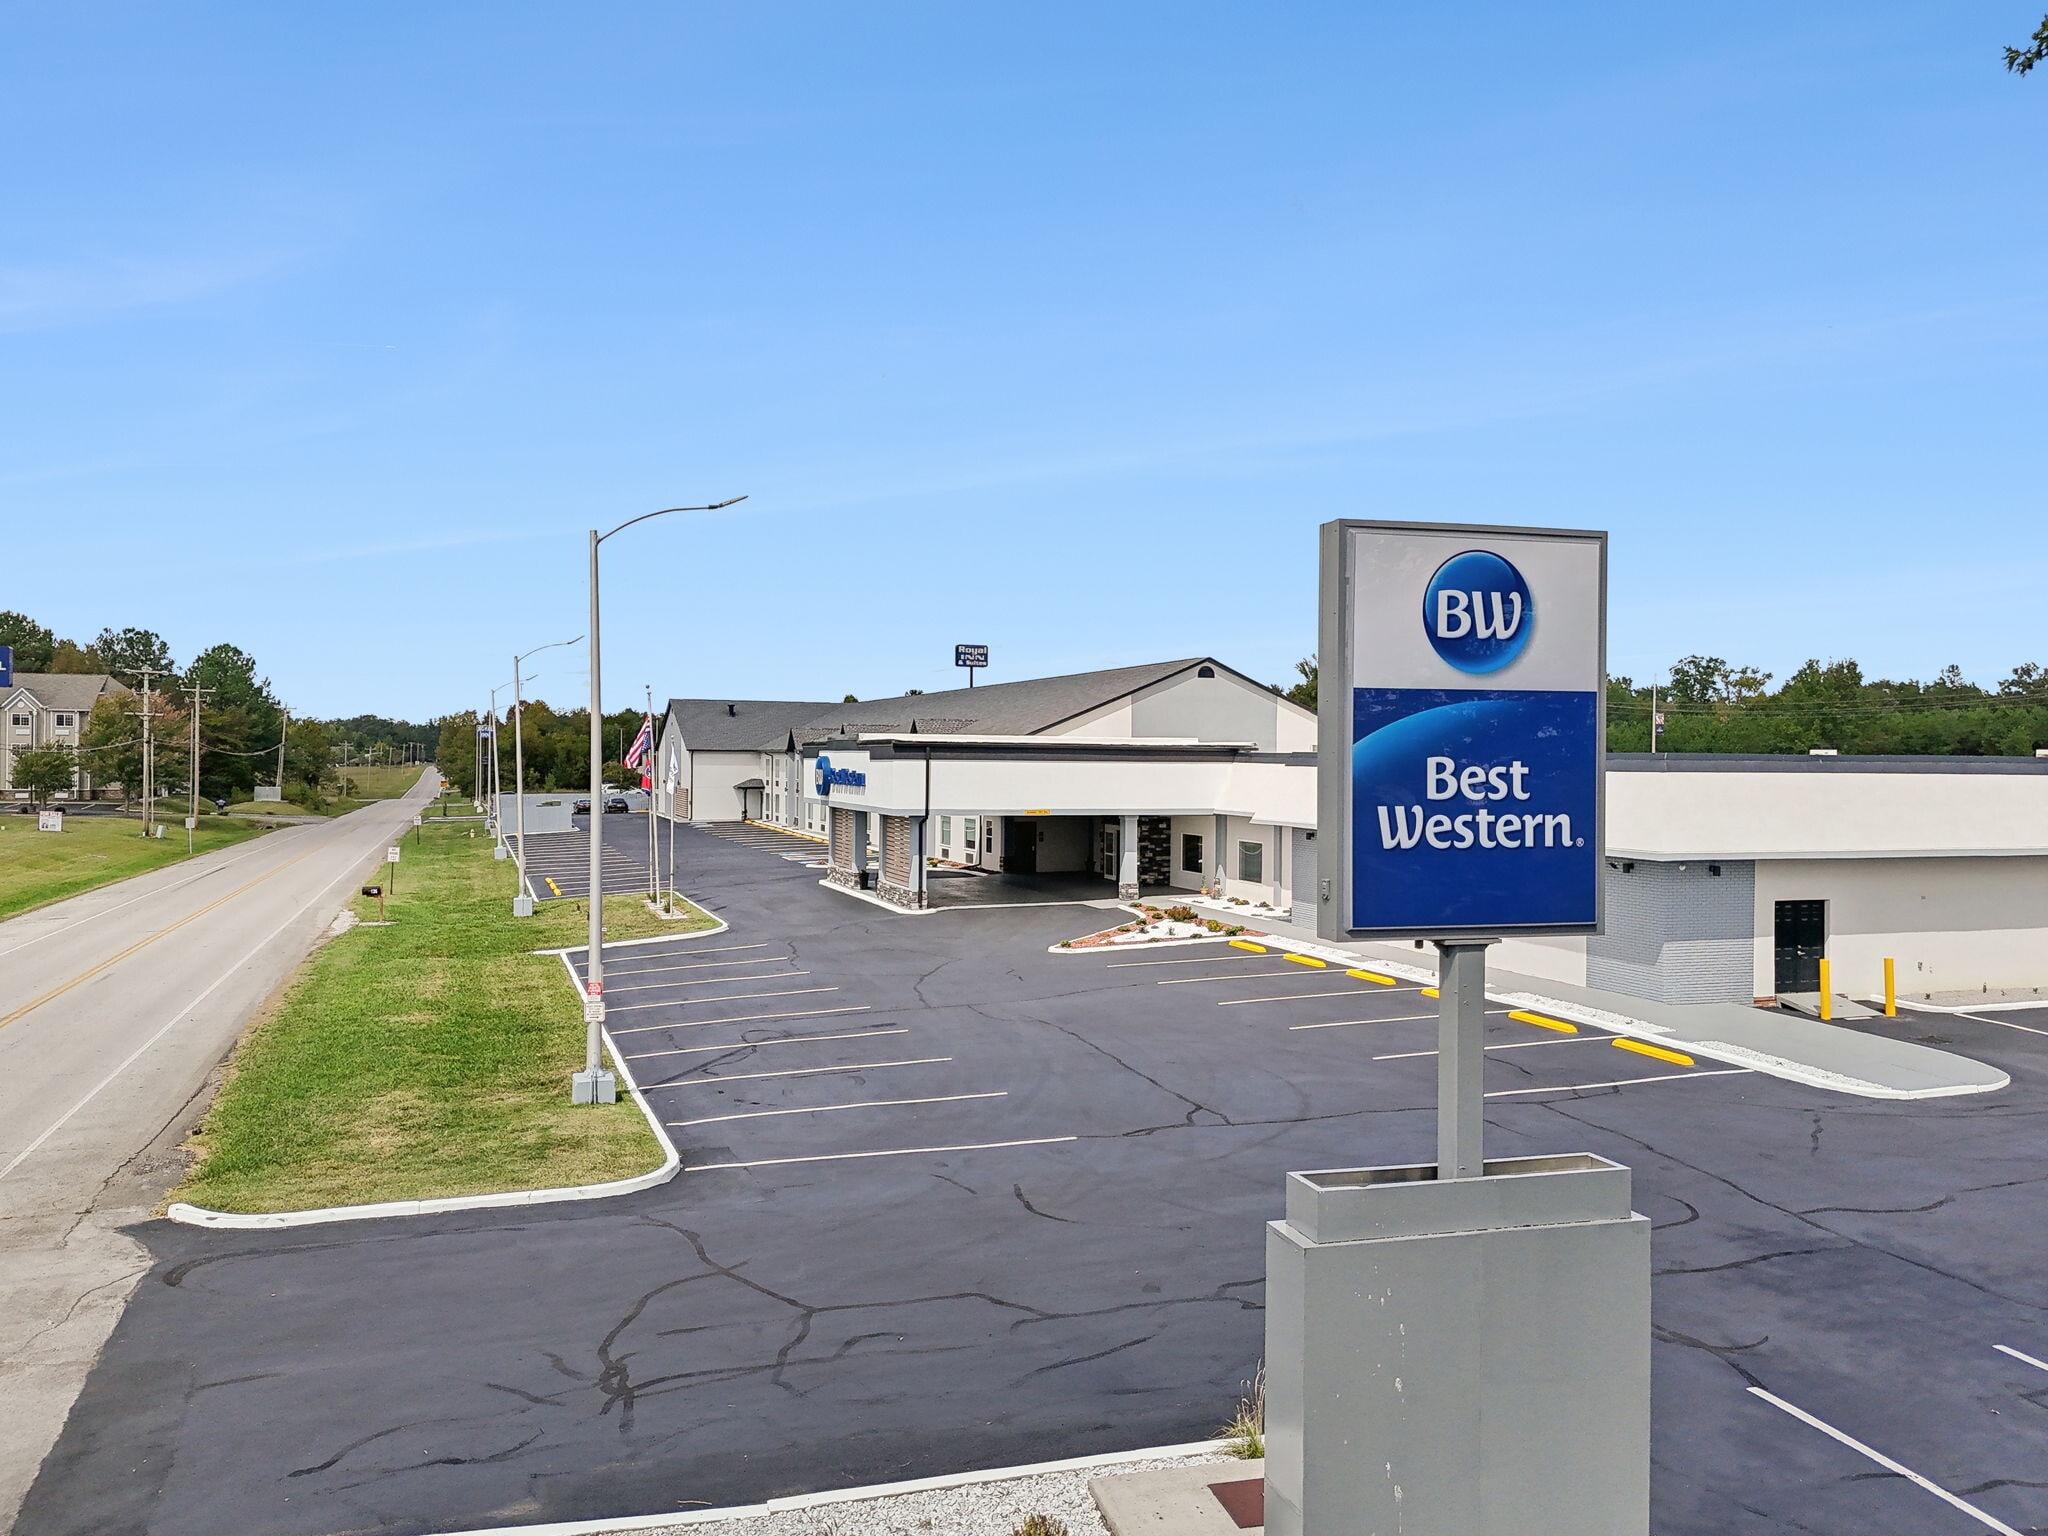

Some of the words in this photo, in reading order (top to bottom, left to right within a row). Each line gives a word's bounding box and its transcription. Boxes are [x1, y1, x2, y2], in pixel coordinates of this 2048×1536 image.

[1437, 589, 1521, 640] BW
[958, 645, 987, 655] Royal
[1426, 756, 1530, 801] Best
[1377, 805, 1573, 850] Western
